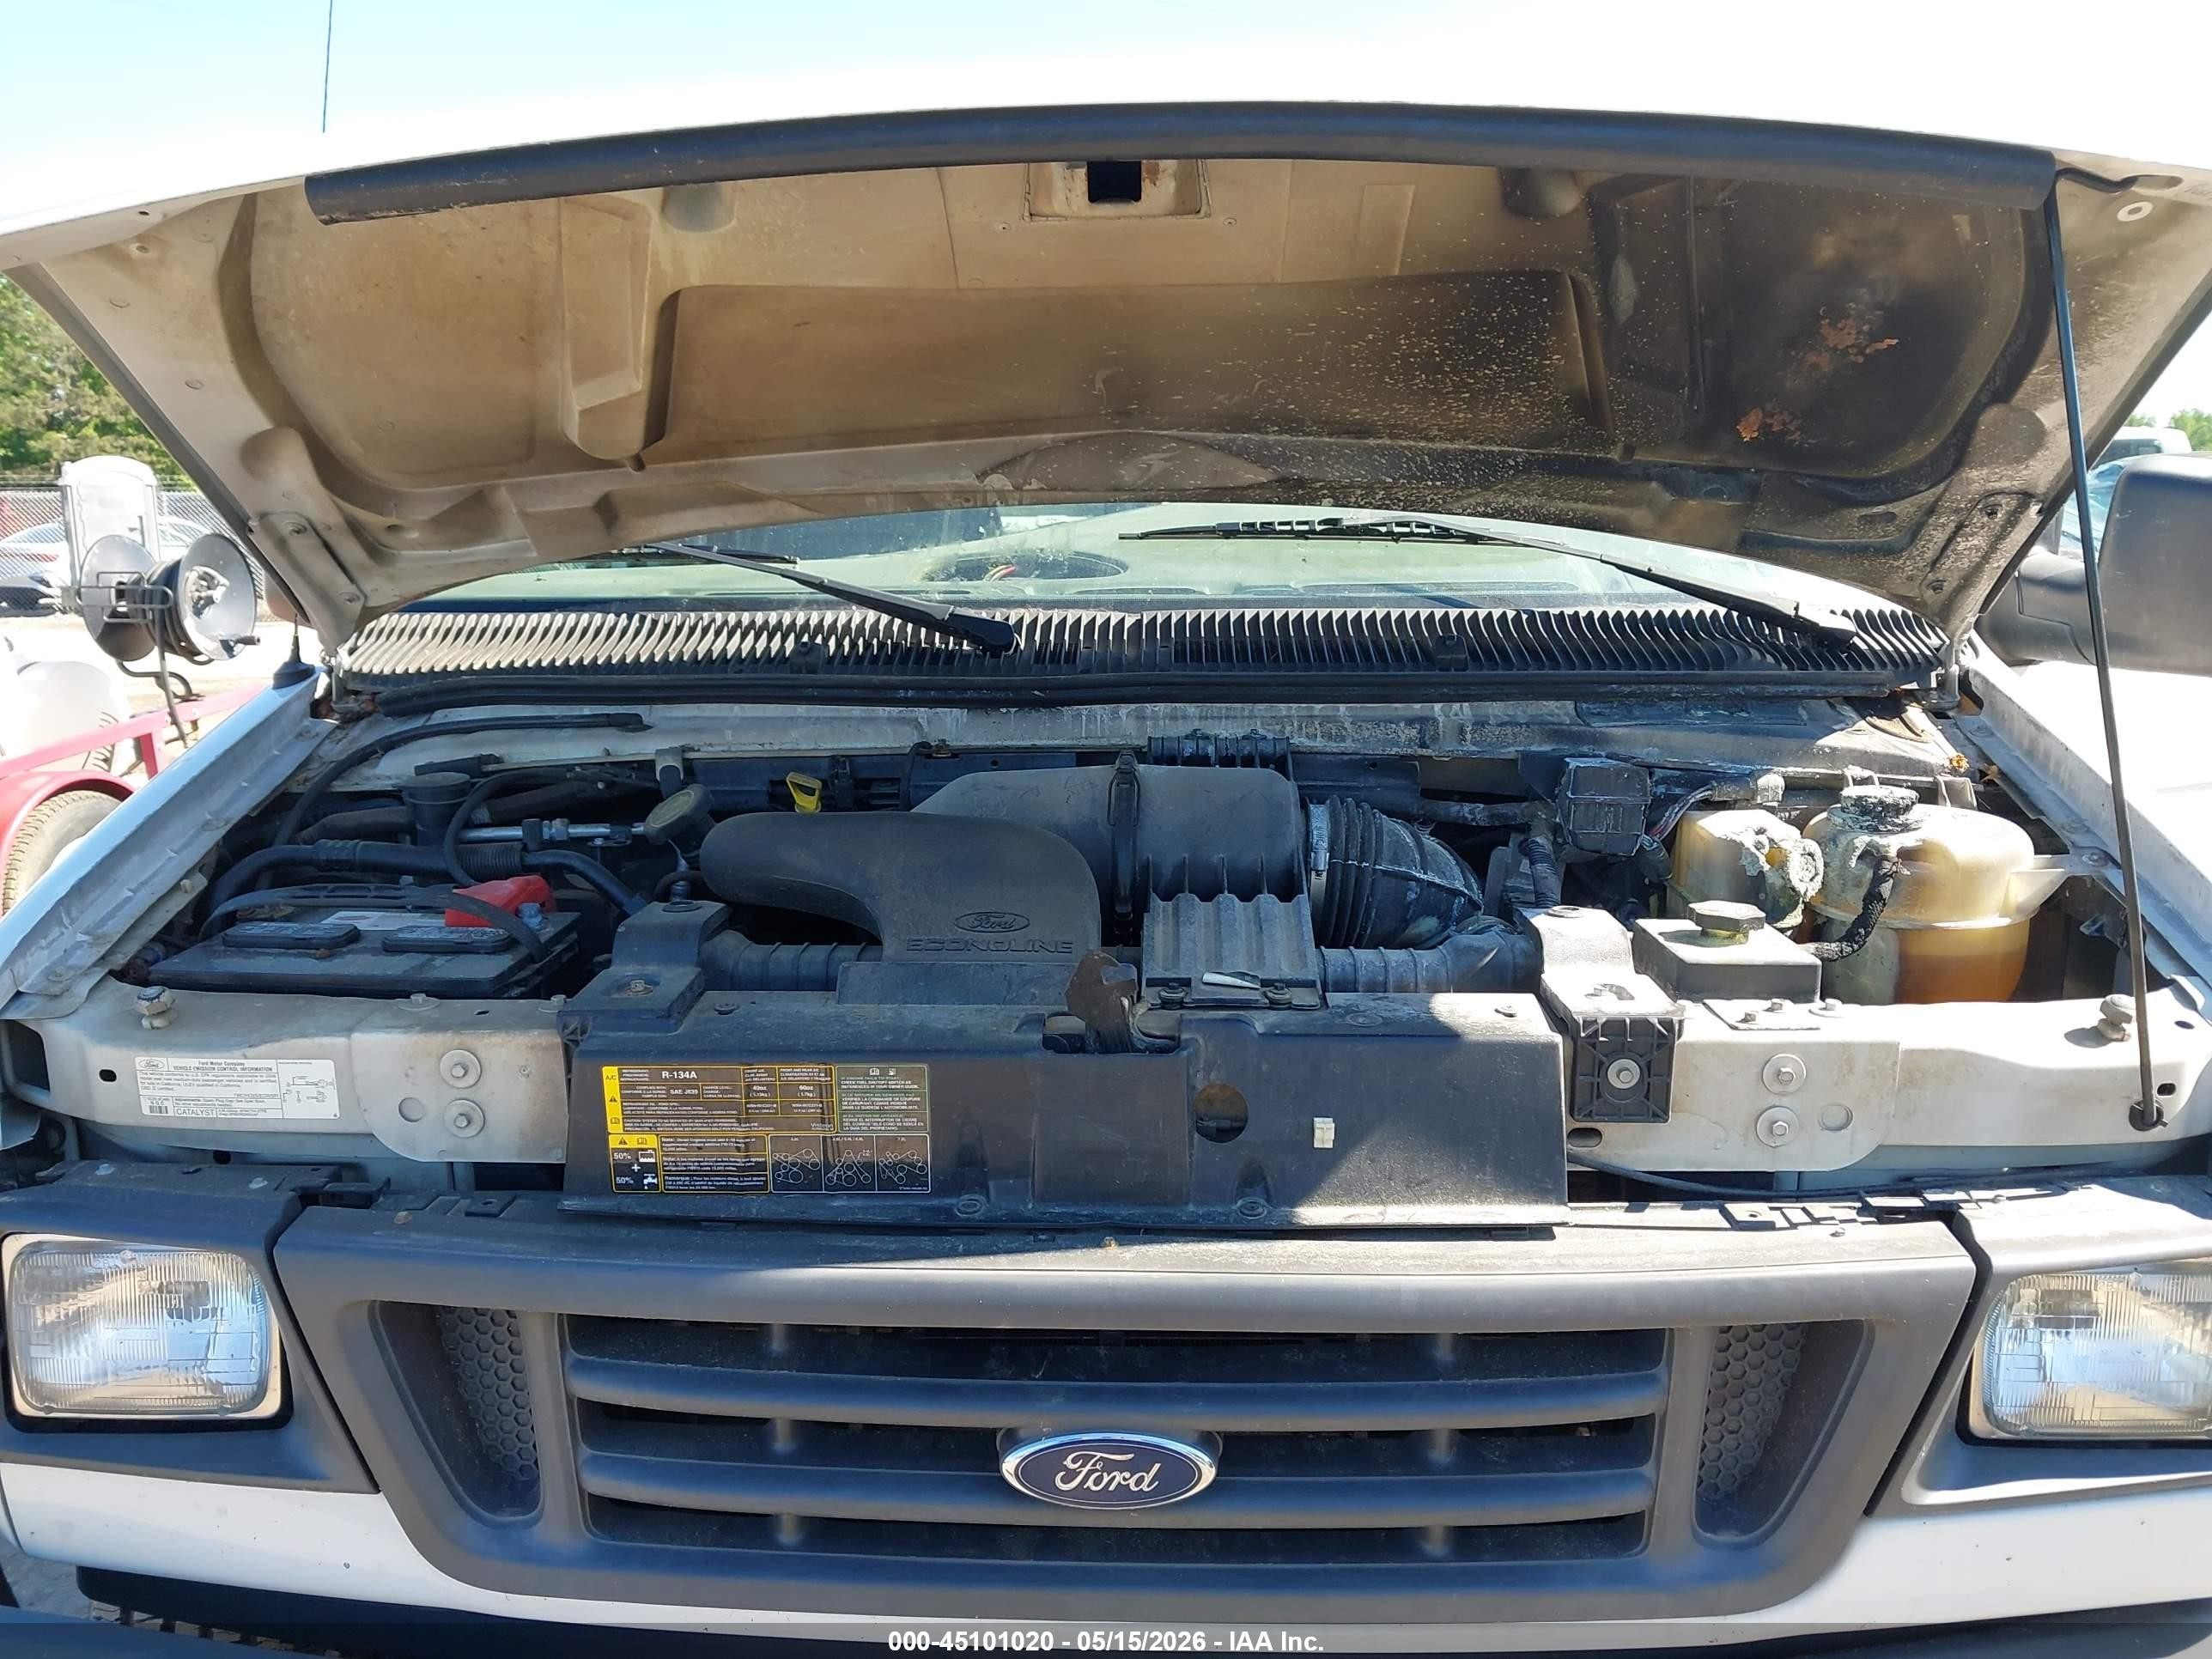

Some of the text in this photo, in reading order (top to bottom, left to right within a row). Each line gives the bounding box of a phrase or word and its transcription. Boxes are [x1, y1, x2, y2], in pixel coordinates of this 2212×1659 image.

[968, 915, 1017, 929] Ford
[907, 938, 1073, 953] ECONOLINE
[661, 1071, 697, 1079] R-134A
[616, 1176, 634, 1185] 50%
[1054, 1451, 1161, 1491] Ford
